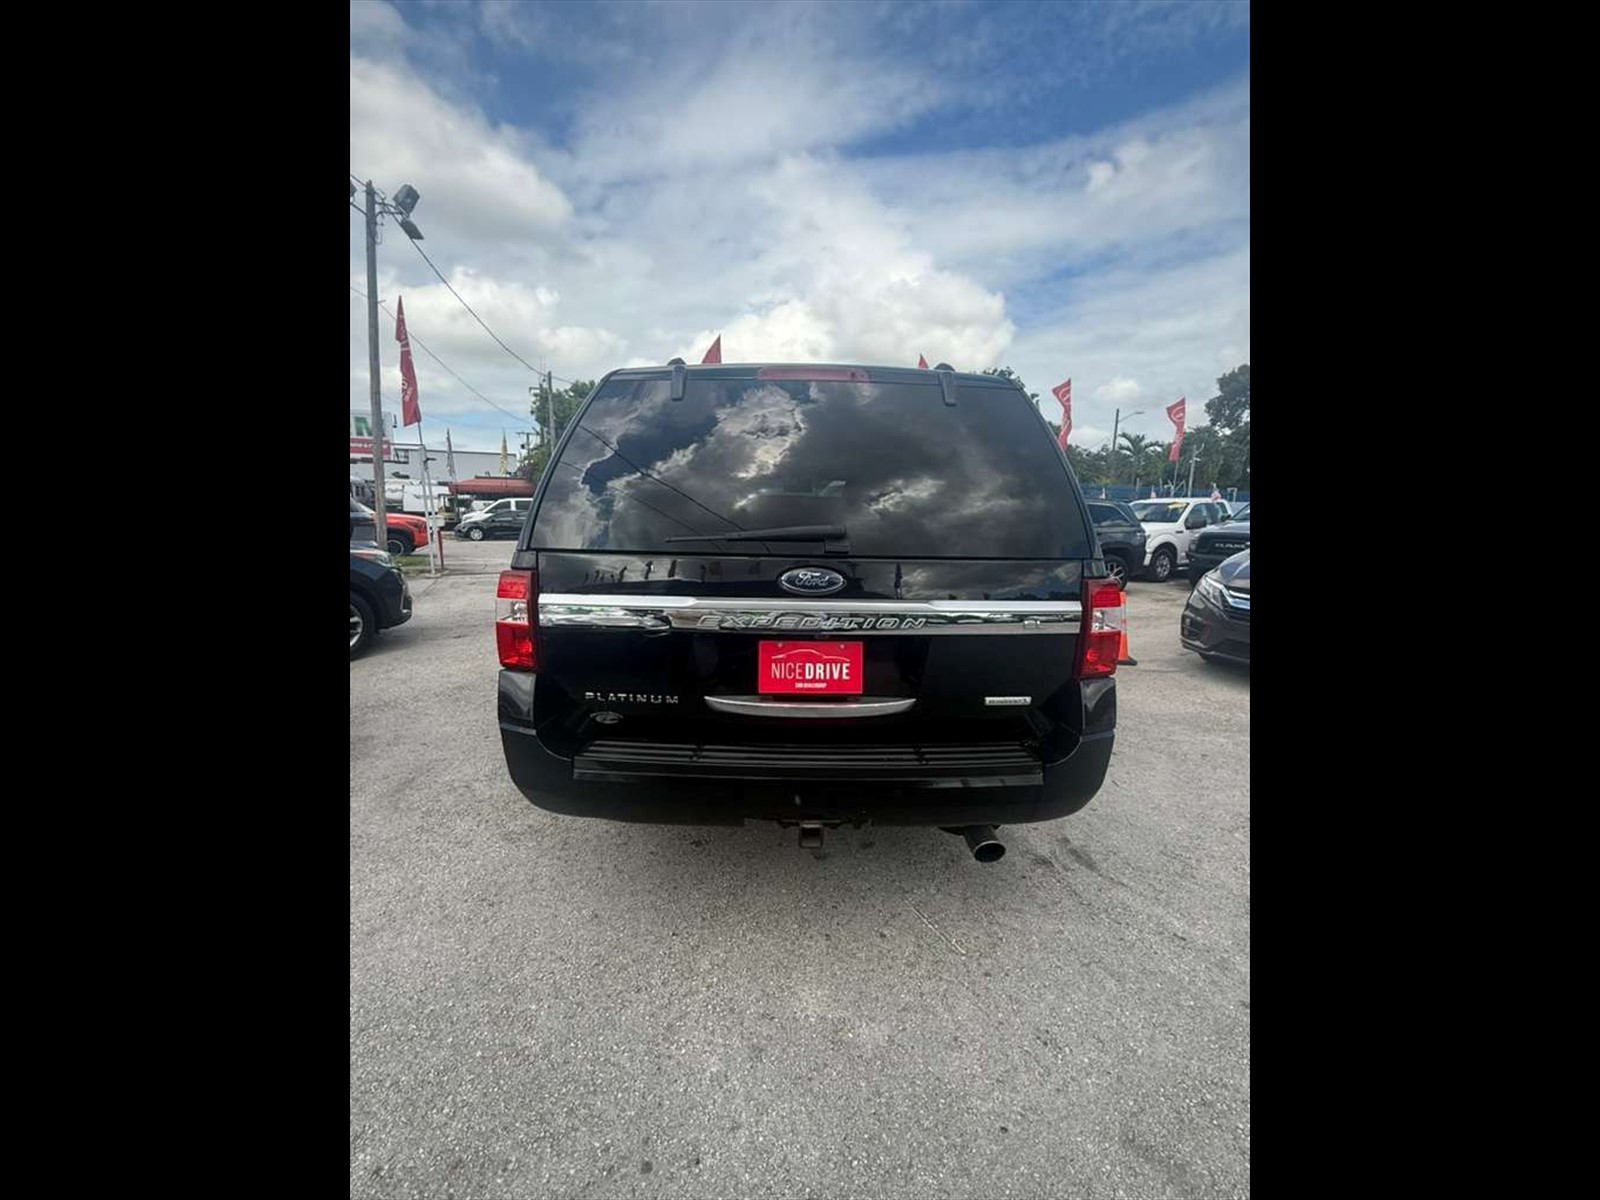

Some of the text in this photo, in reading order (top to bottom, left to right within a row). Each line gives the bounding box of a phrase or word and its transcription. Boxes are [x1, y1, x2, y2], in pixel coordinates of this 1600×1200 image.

[795, 571, 829, 586] Ford
[697, 615, 925, 629] EXPEDITION
[585, 691, 679, 704] PLATINUM
